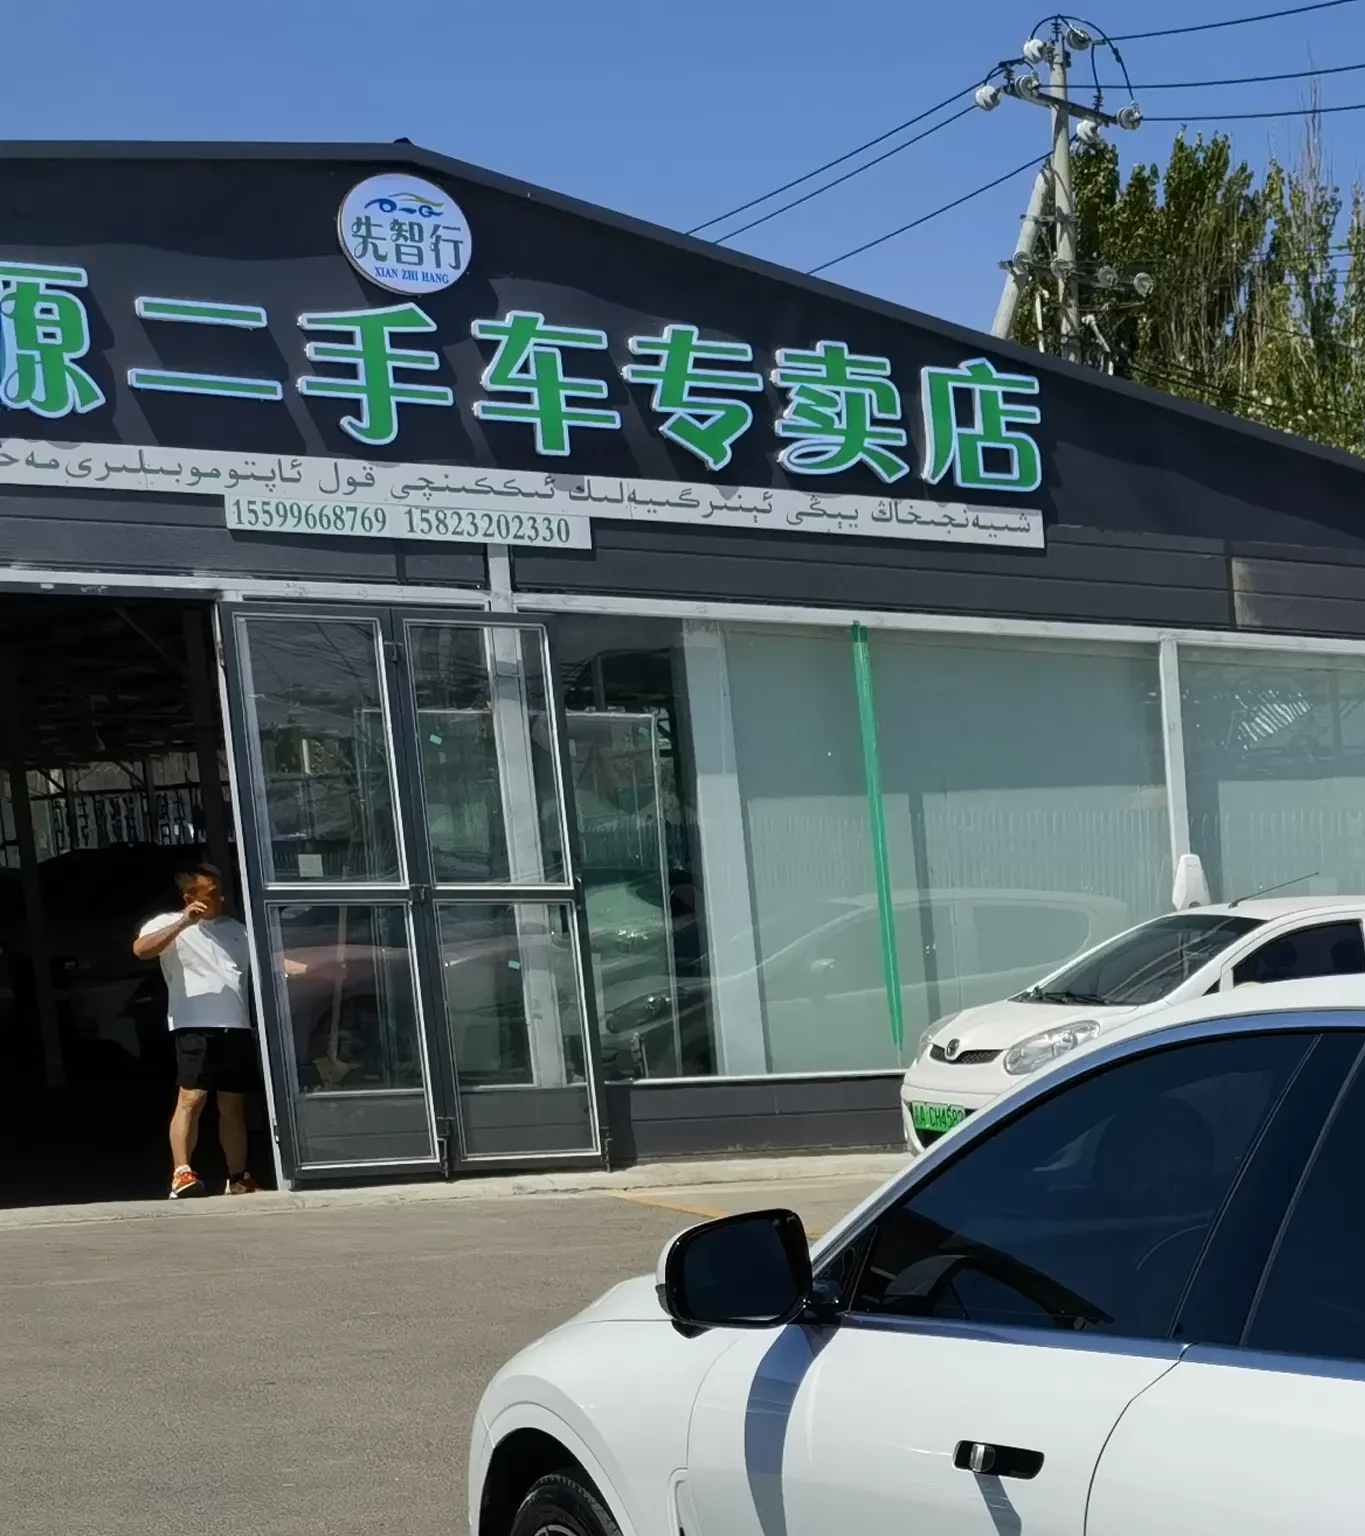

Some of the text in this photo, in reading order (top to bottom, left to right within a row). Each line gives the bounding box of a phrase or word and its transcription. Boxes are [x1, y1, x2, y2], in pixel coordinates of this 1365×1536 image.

[351, 215, 464, 271] 先智行
[374, 266, 449, 285] XIAN ZHI HANG
[318, 461, 376, 495] قول
[232, 498, 570, 543] 15599668769 15823202330
